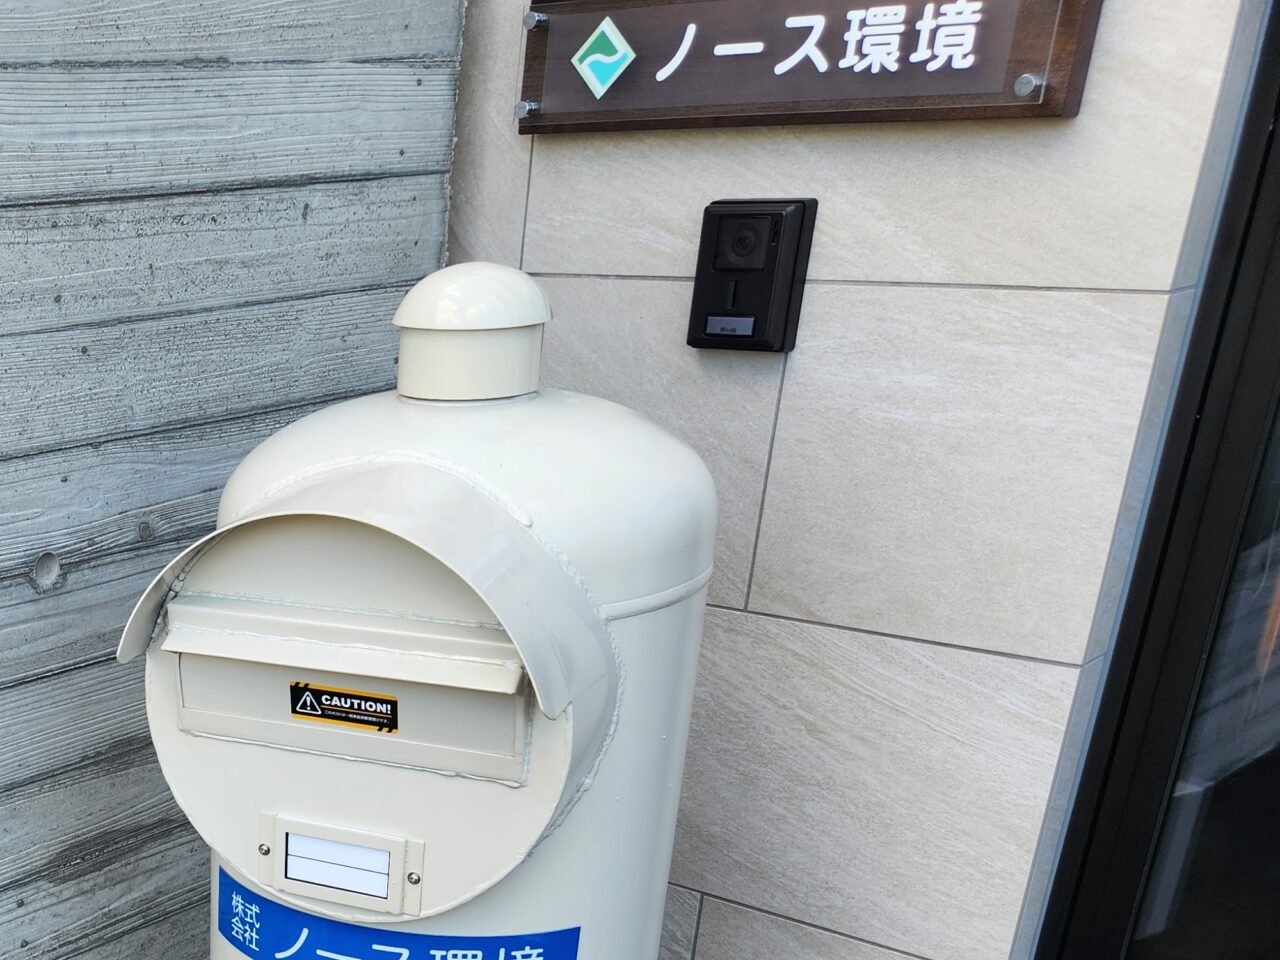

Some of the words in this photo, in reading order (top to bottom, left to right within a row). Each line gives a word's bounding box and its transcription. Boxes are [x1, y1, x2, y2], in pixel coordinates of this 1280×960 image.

[655, 0, 983, 83] ノース環境
[321, 694, 392, 714] CAUTION!
[231, 891, 260, 929] 株式
[231, 916, 260, 951] 会社
